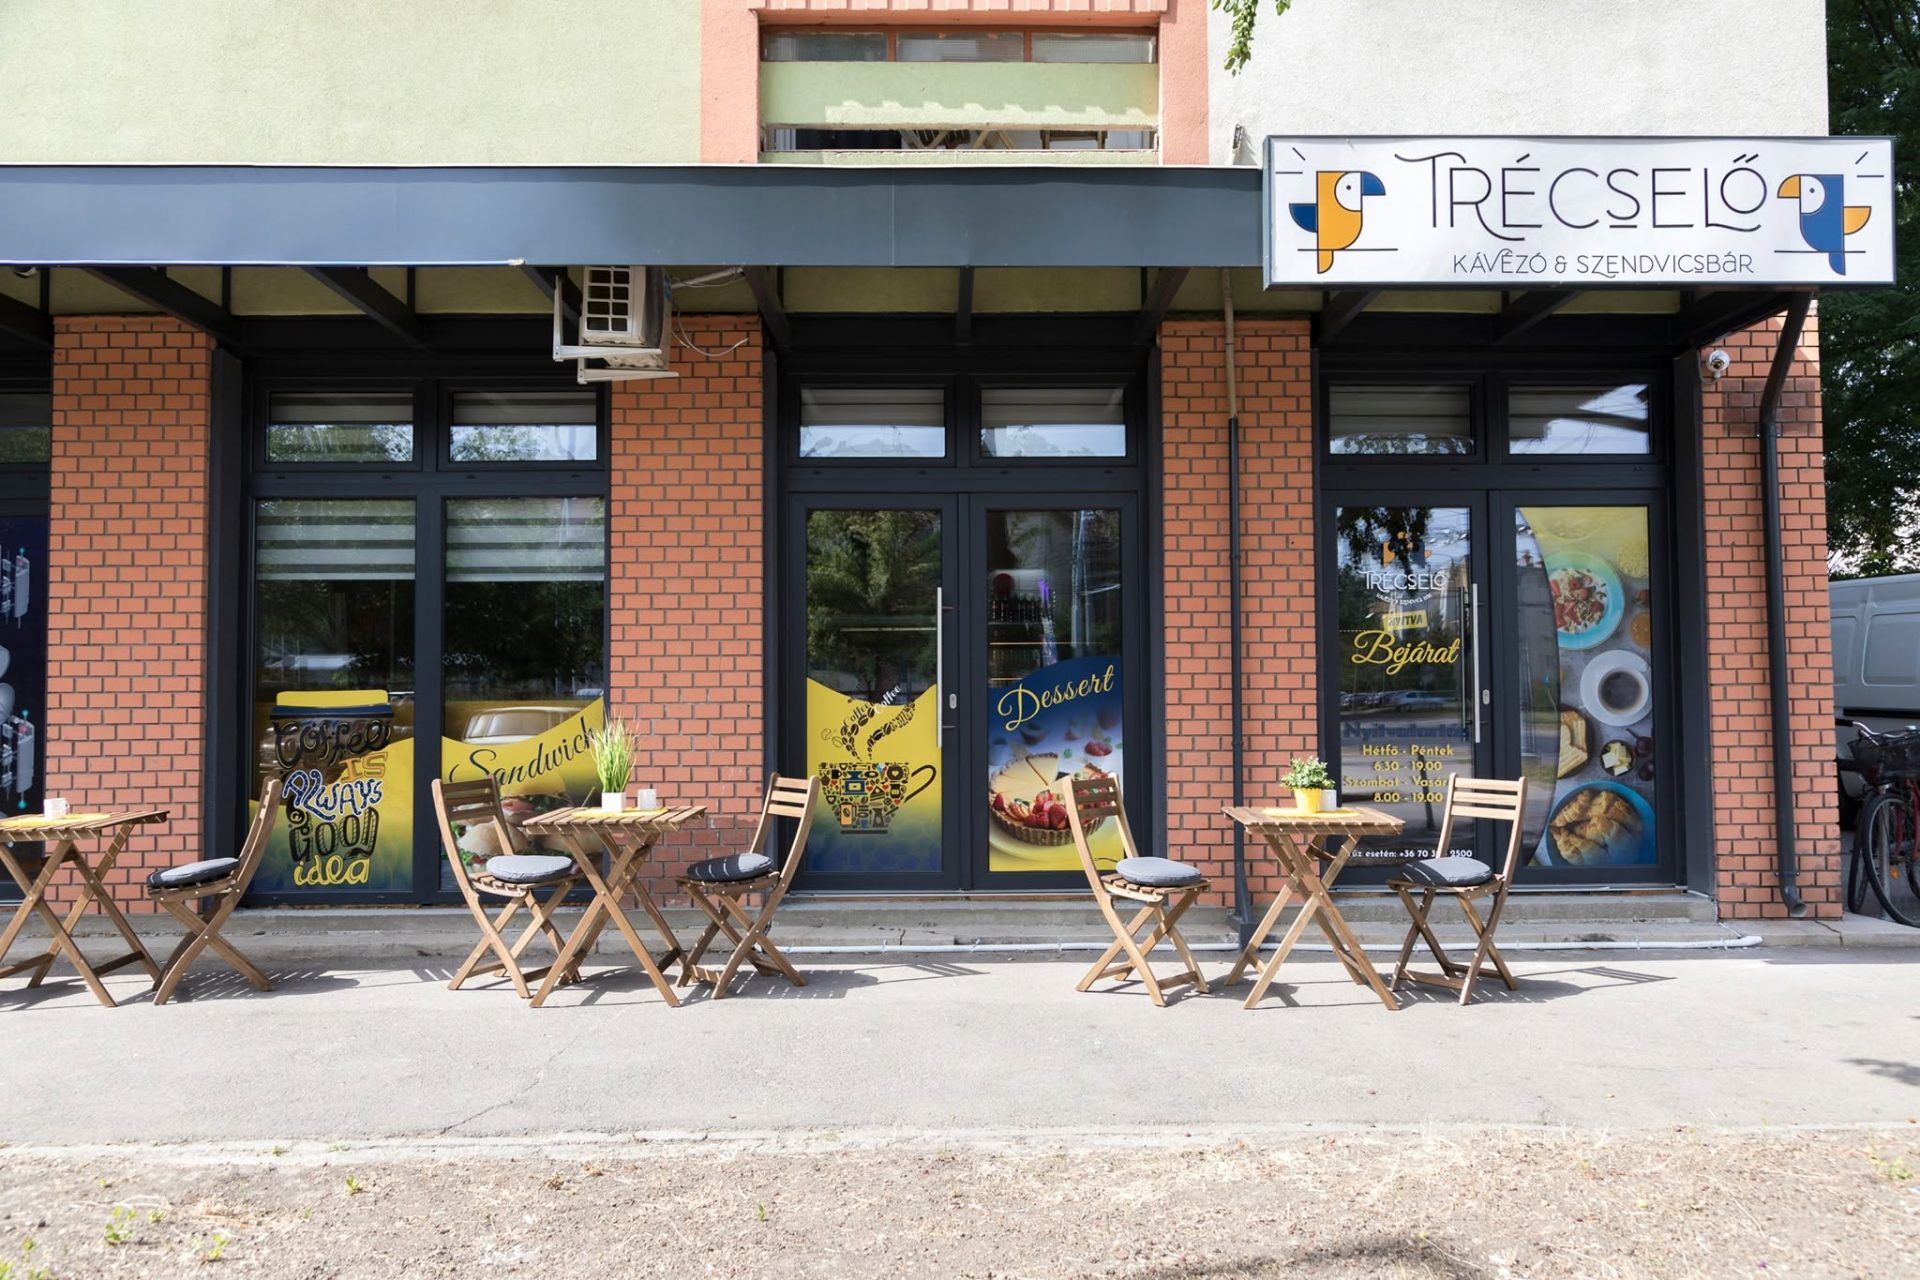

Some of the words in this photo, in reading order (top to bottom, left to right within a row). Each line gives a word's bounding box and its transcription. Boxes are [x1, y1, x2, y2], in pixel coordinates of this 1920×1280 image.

[1394, 151, 1768, 241] TRÉCSELŐ
[1452, 248, 1548, 274] KÁVÉZÓ
[1553, 254, 1568, 275] &
[1357, 569, 1448, 593] TRÉCSELŐ
[1351, 630, 1461, 676] Bejárat
[997, 664, 1115, 732] Dessert
[448, 716, 595, 786] Sandwich
[1362, 743, 1399, 757] Hétfő
[1411, 743, 1455, 757] Péntek
[339, 751, 389, 782] IS
[1411, 760, 1443, 772] 19.00
[1343, 775, 1399, 788] Szombat
[1373, 792, 1400, 803] 8.00
[1412, 791, 1443, 803] 19.00
[1418, 848, 1429, 858] 70
[293, 855, 371, 887] idea
